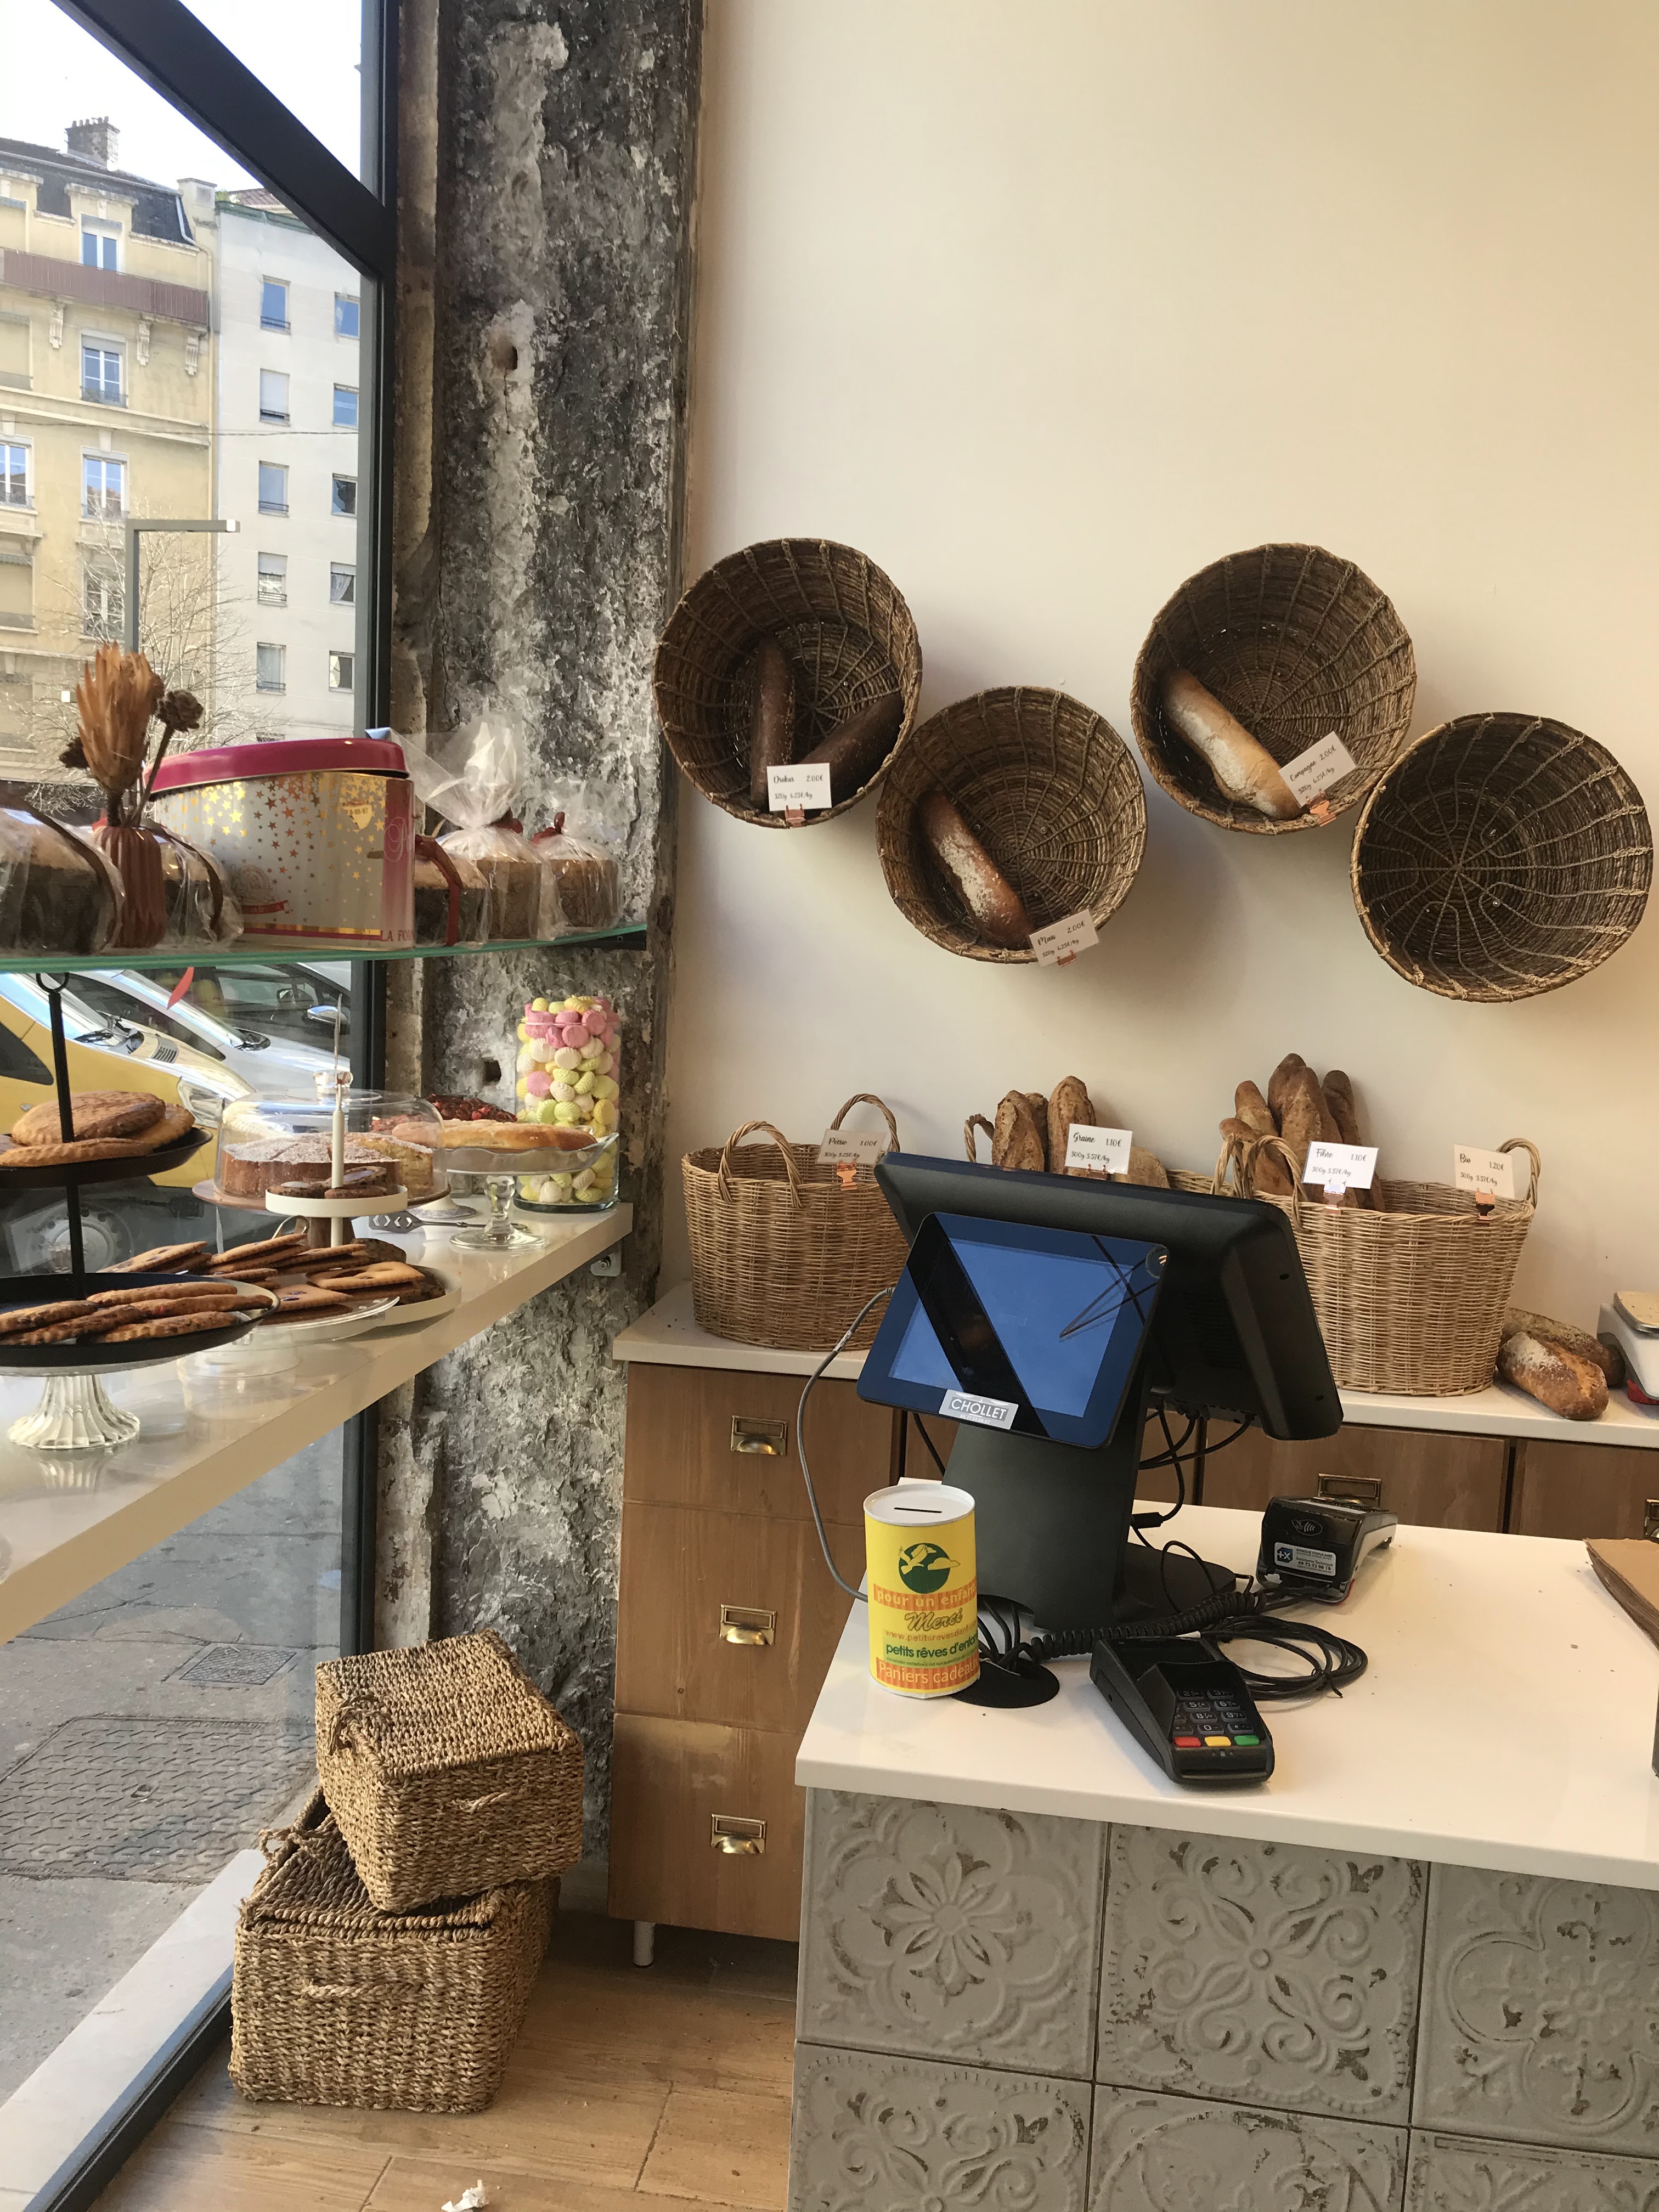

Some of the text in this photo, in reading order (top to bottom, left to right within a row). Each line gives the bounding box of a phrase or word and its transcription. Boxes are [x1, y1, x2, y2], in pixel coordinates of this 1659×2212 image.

[380, 930, 393, 942] LA
[1073, 1132, 1122, 1147] Graine 1.10€
[1071, 1150, 1085, 1161] 300g
[1316, 1148, 1368, 1162] Fibre 1.10€
[1459, 1153, 1471, 1164] Bio
[951, 1398, 1007, 1420] CHOLLET
[878, 1590, 909, 1606] pour
[916, 1597, 934, 1607] un
[904, 1607, 963, 1632] Merci
[886, 1644, 915, 1658] petits
[916, 1647, 947, 1658] rêves
[879, 1658, 979, 1684] Paniers cadeaux
